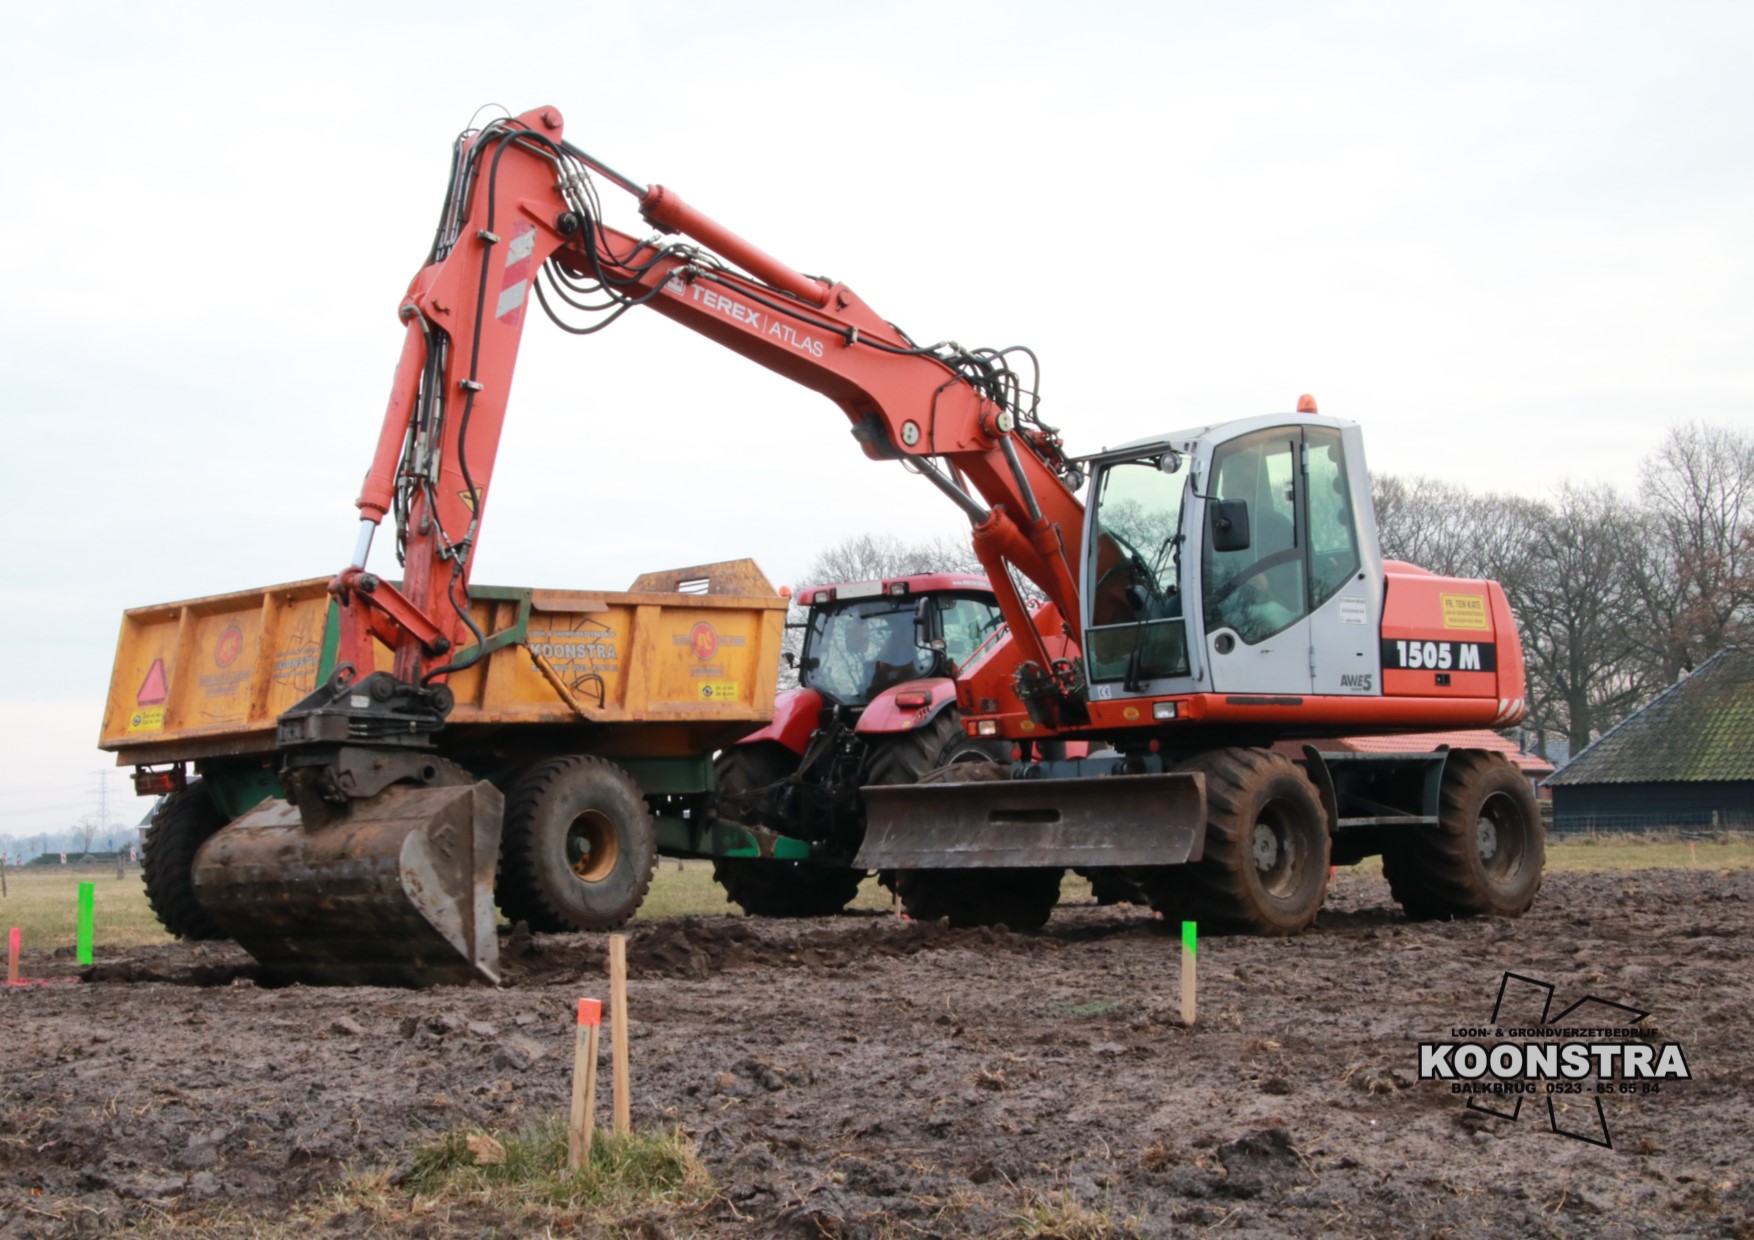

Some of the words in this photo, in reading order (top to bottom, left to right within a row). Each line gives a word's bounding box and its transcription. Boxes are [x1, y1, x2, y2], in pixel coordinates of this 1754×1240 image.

[692, 283, 760, 328] TEREX
[769, 321, 825, 358] ATLAS
[529, 643, 617, 660] KOONSTRA
[1396, 640, 1452, 669] 1505
[1459, 643, 1481, 670] M
